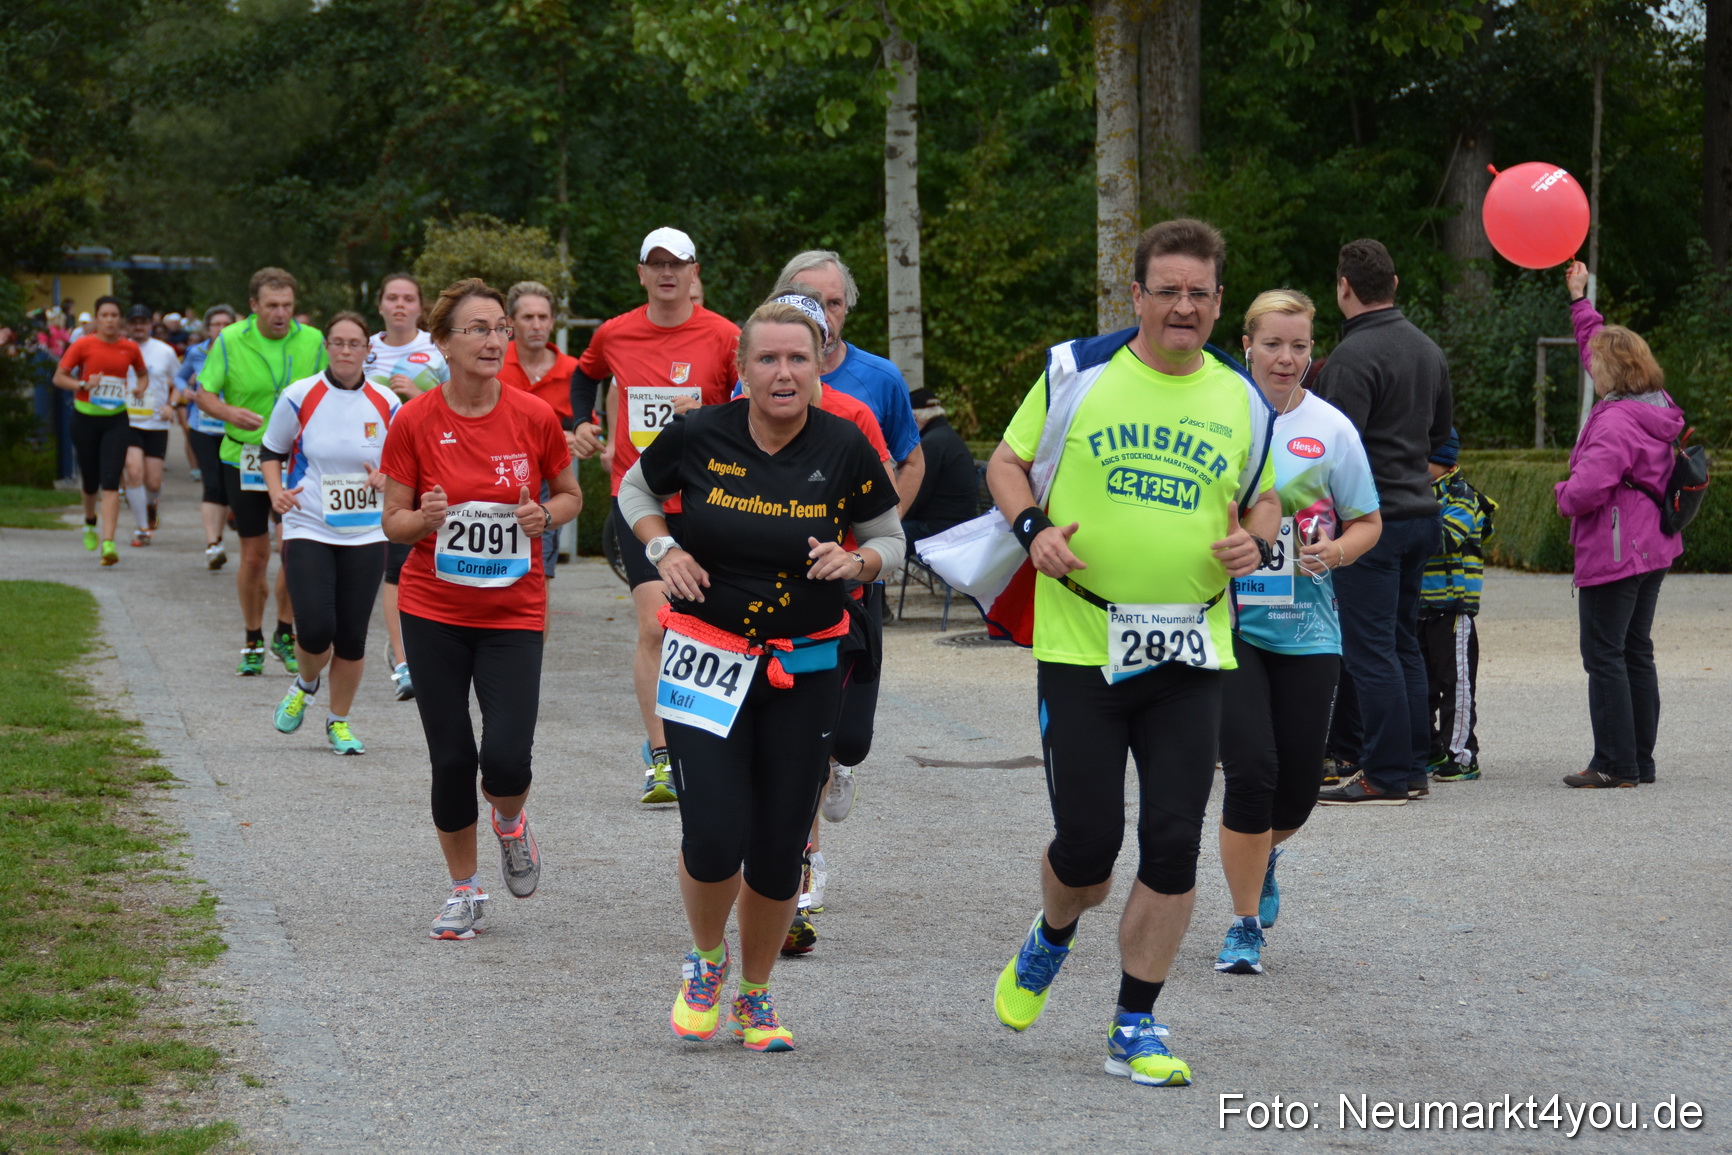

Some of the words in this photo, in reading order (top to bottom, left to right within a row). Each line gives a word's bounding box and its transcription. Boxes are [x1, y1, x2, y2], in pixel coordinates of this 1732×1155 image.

[93, 384, 123, 398] 2772
[629, 393, 654, 401] PARTL
[1187, 418, 1205, 428] asics
[1087, 422, 1229, 482] FINISHER
[1292, 440, 1322, 454] Hervis
[707, 458, 747, 477] Angelas
[1100, 455, 1121, 467] ASICS
[1121, 452, 1162, 462] STOCKHOLM
[1163, 456, 1199, 474] MARATHON
[1198, 471, 1213, 486] 2015
[329, 488, 378, 511] 3094
[706, 486, 827, 519] Marathon-Team
[474, 510, 515, 519] Neumarkt
[447, 520, 518, 555] 2091
[457, 560, 508, 576] Cornelia
[1235, 579, 1265, 593] arika
[1111, 613, 1149, 624] PARTL
[1151, 614, 1196, 624] Neumarkt
[1267, 610, 1306, 621] Stadtlauf
[1121, 629, 1208, 667] 2829
[663, 639, 742, 697] 2804
[670, 689, 696, 709] Kati
